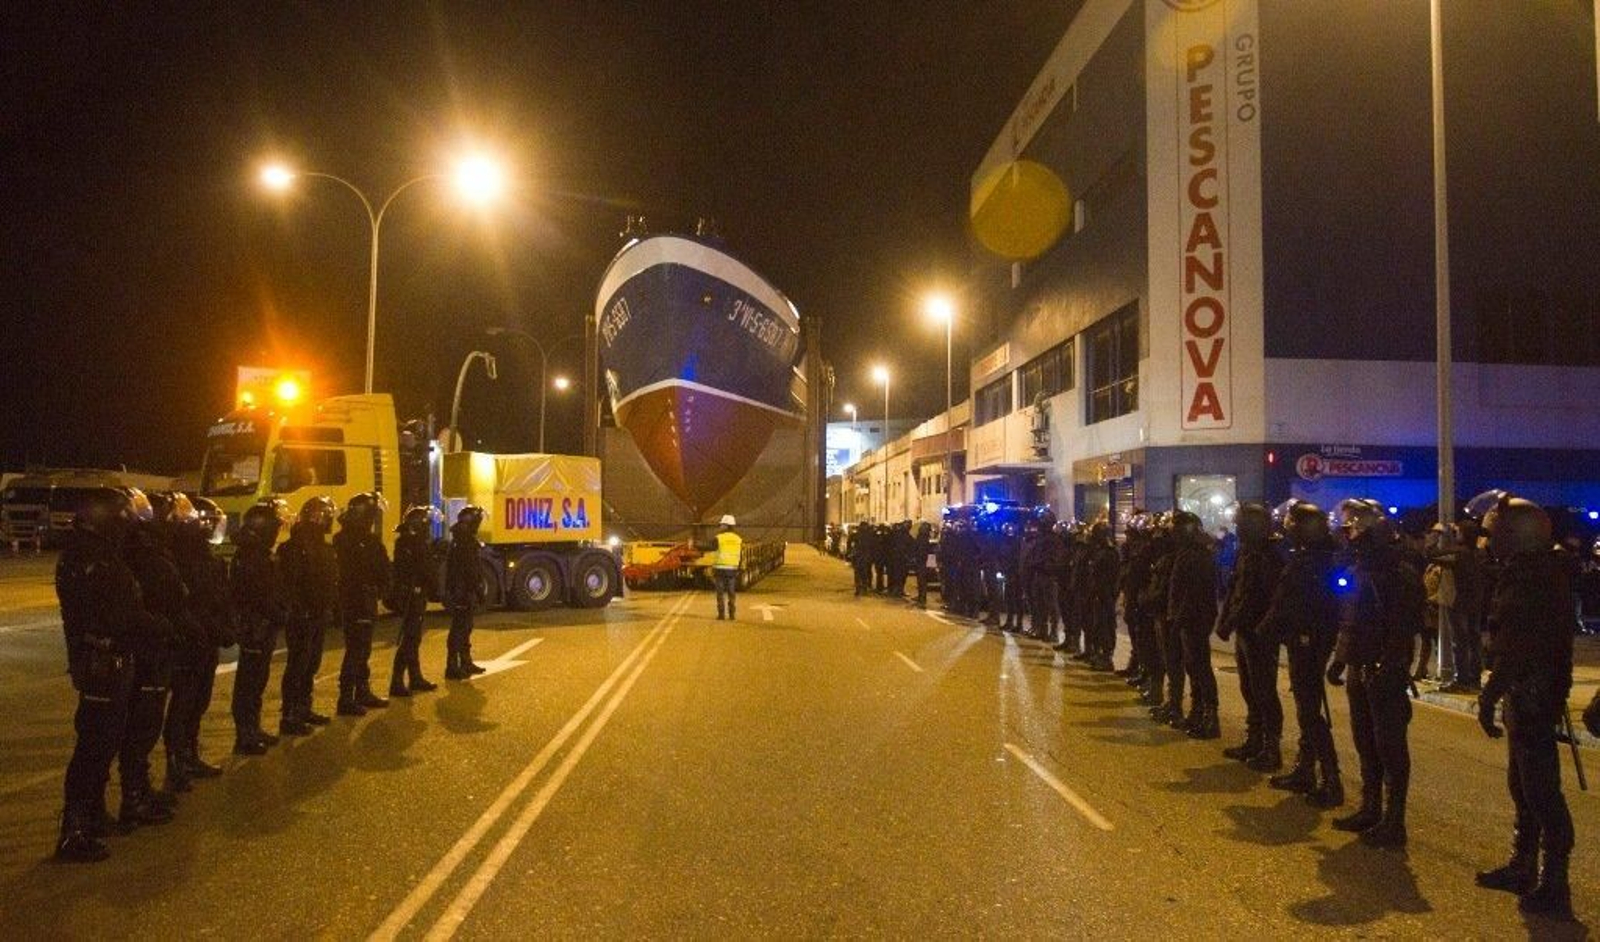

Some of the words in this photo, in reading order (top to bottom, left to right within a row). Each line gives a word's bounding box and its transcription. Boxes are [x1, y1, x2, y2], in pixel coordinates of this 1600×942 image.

[1235, 33, 1256, 122] GRUPO
[1185, 44, 1225, 423] PESCANOVA
[1328, 461, 1402, 475] PESCANOVA
[505, 497, 558, 533] DONIZ,
[561, 497, 590, 529] S.A.
